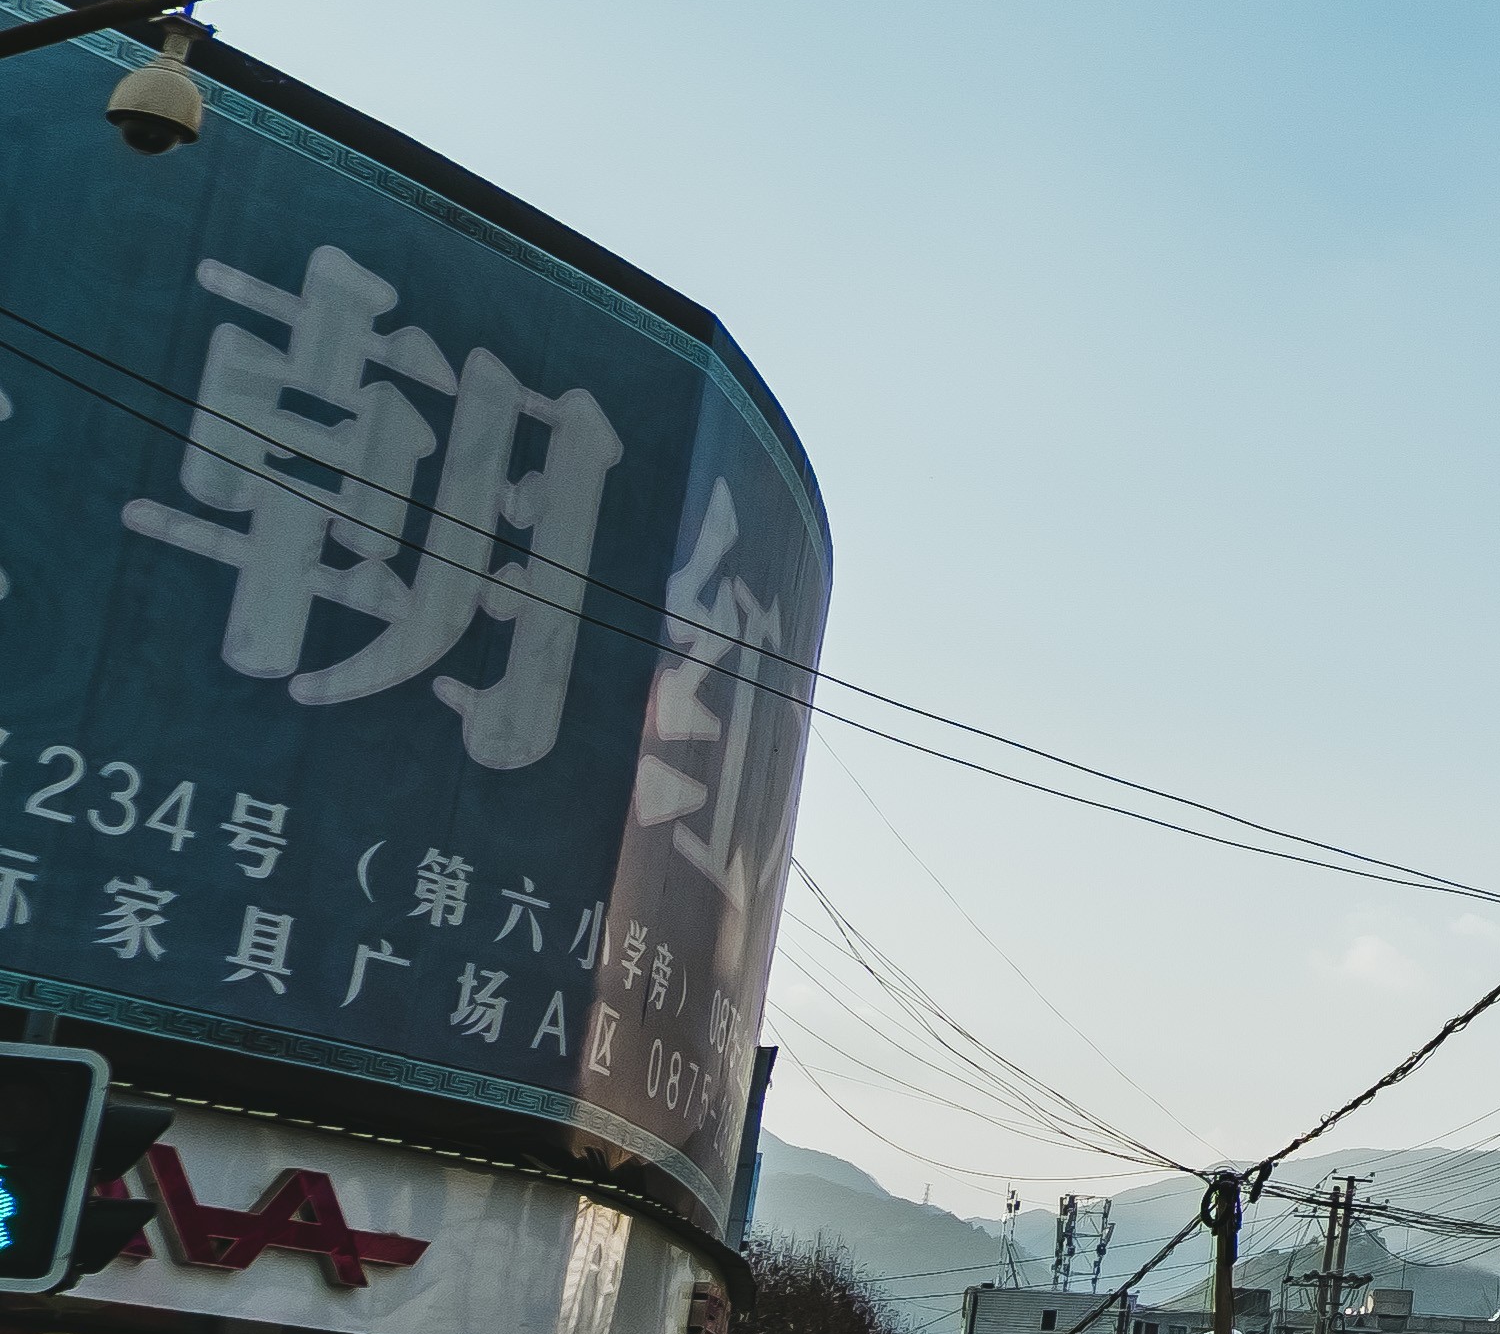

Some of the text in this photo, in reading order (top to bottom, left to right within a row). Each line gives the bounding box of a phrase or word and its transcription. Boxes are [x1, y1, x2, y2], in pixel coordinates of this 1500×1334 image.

[0, 725, 688, 1018] 234号（第六小学旁）
